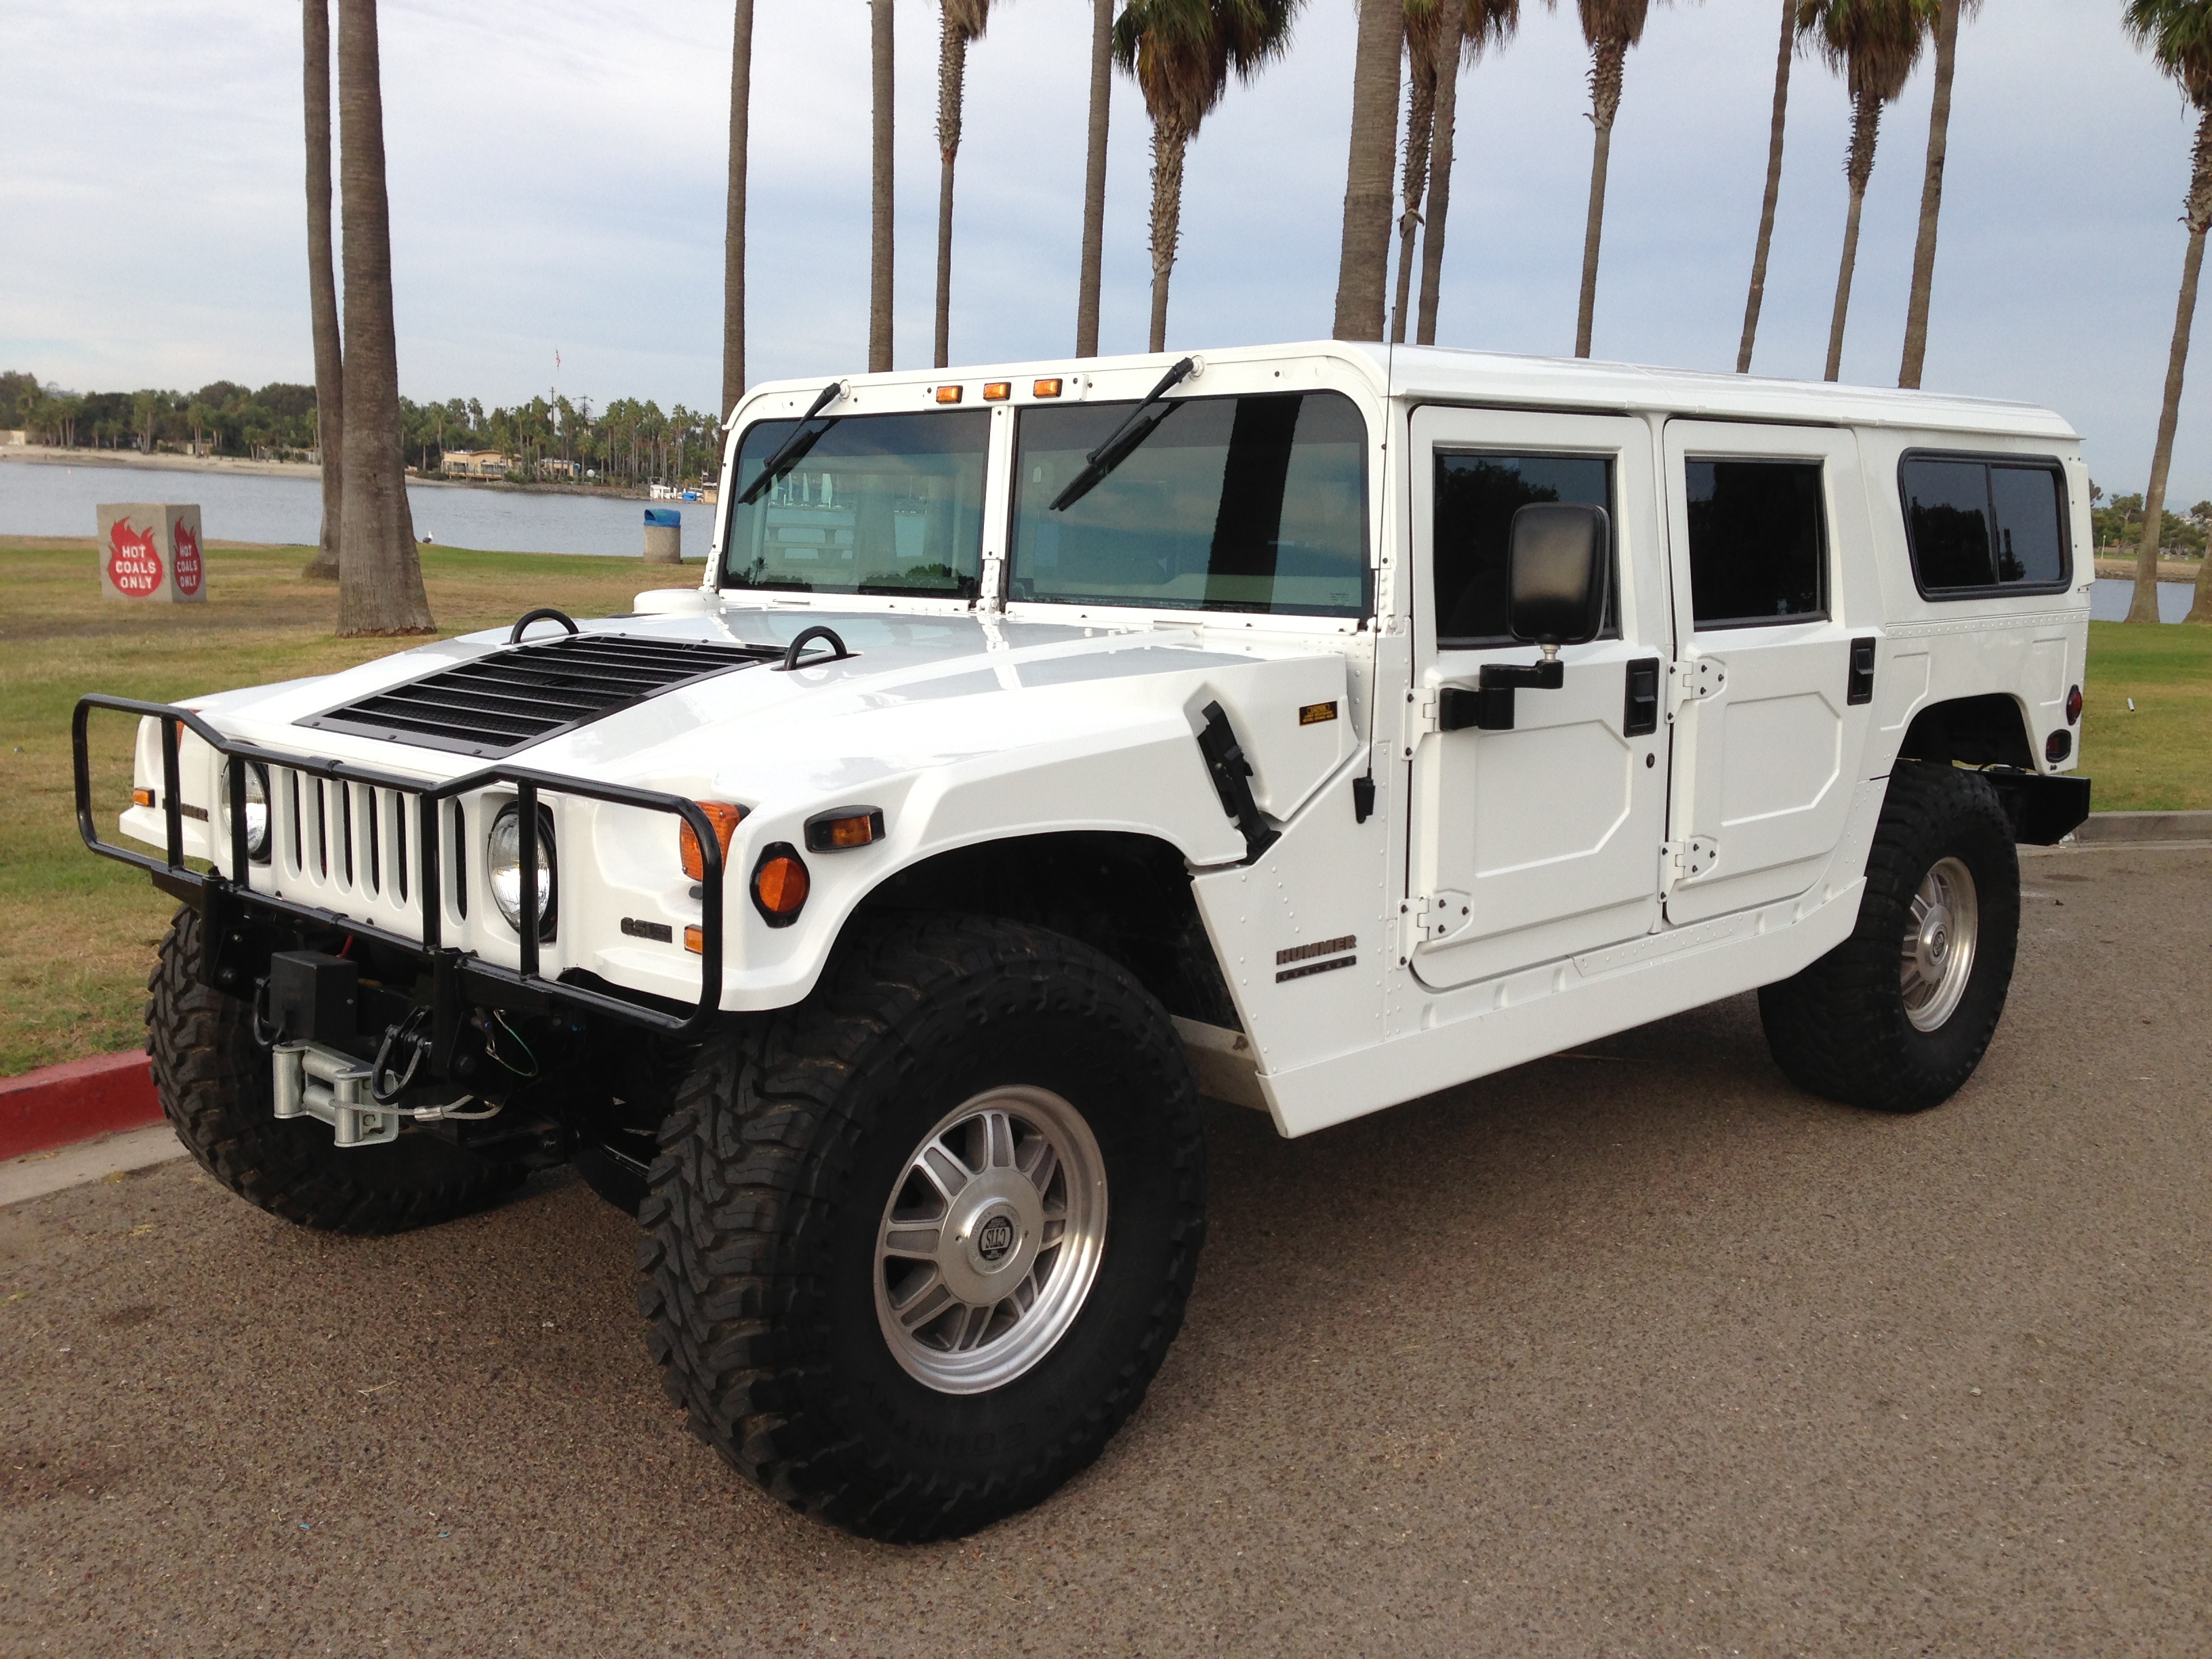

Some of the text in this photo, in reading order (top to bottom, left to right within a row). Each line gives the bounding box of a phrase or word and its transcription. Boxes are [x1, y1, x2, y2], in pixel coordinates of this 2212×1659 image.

[122, 545, 146, 558] HOT
[180, 544, 192, 557] HOT
[115, 561, 157, 574] COALS
[177, 560, 198, 573] COALS
[120, 576, 152, 589] ONLY
[180, 575, 197, 588] ONLY
[1276, 935, 1357, 965] HUMMER
[985, 1228, 1006, 1248] CTIS
